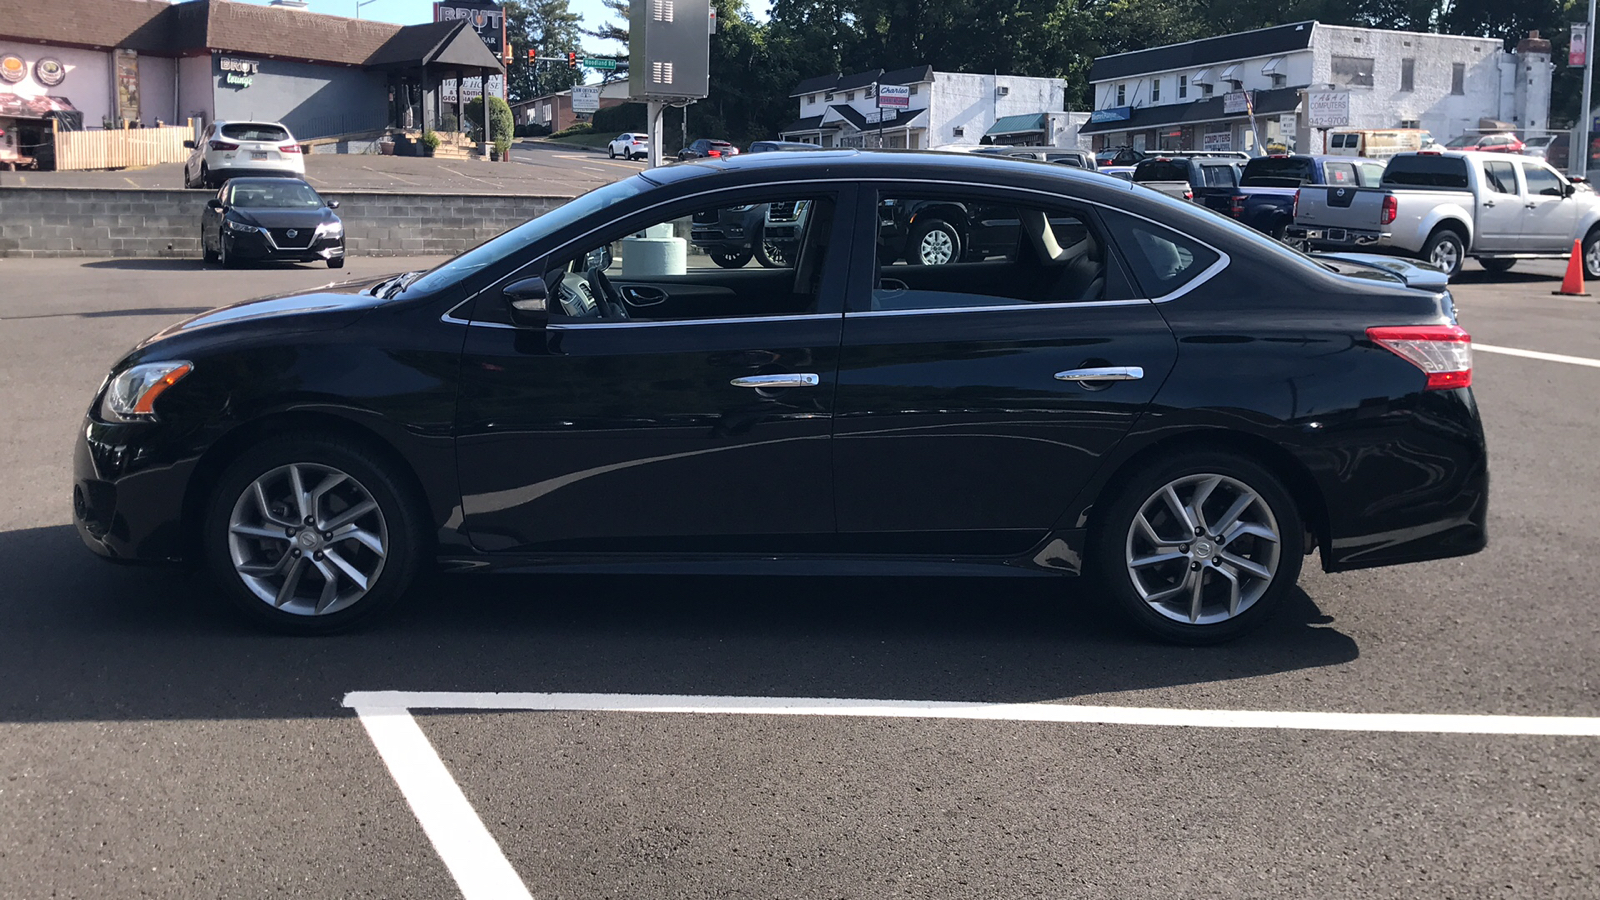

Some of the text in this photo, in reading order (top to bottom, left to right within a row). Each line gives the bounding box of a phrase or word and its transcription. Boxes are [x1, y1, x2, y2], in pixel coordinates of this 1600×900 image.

[440, 7, 503, 29] BRUT
[220, 57, 259, 73] BRUT
[227, 73, 253, 88] lounge
[445, 80, 500, 89] WIE HOSE
[1310, 101, 1346, 110] COMPUTERS
[1309, 116, 1347, 126] 942-9700
[1205, 134, 1230, 144] COMPUTERS
